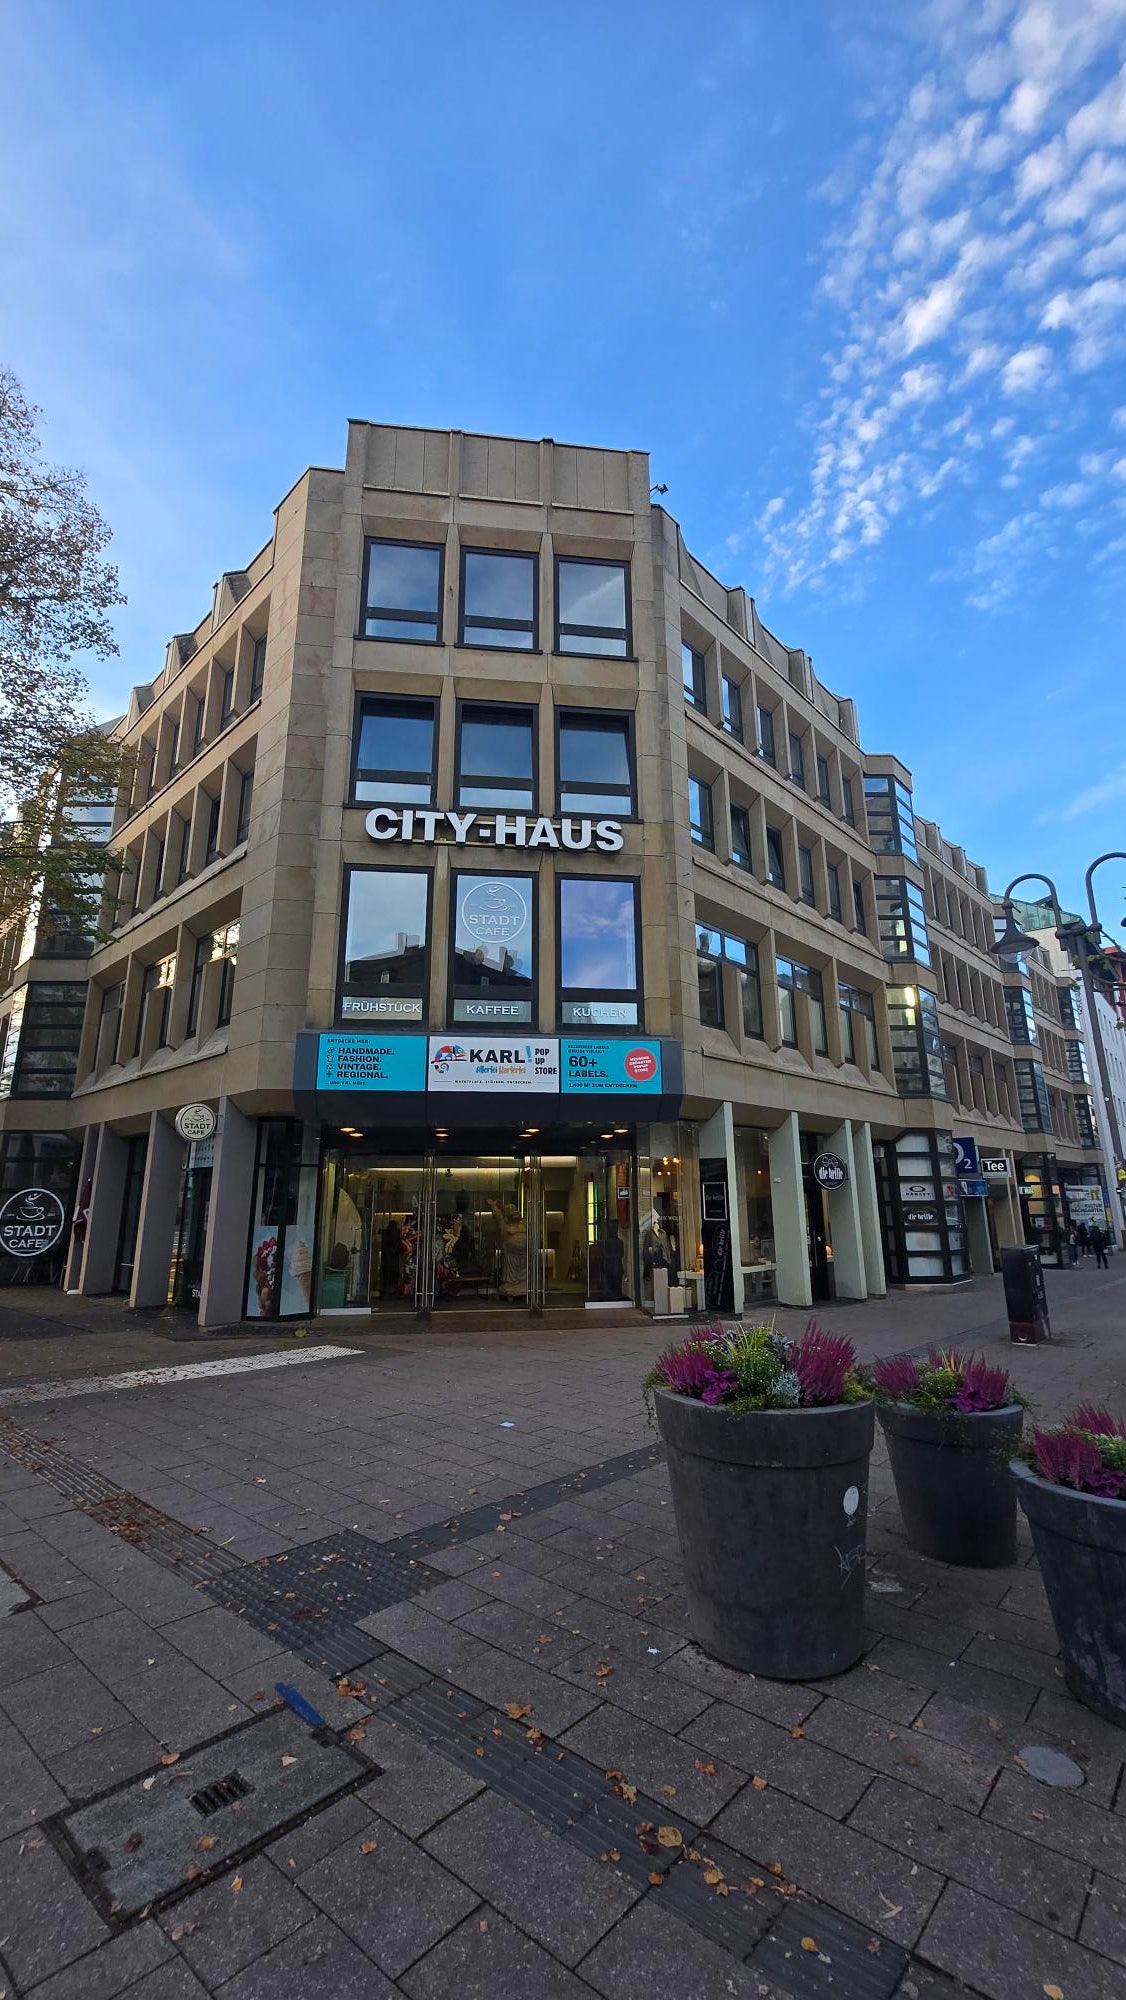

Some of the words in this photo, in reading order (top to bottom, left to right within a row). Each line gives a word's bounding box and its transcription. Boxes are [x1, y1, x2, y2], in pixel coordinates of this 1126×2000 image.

[365, 807, 624, 852] CITY-HAUS
[469, 914, 520, 926] STADT
[476, 927, 509, 936] CAFE
[343, 1000, 421, 1013] FRÜHSTÜCK
[466, 1005, 519, 1016] KAFFEE
[573, 1007, 628, 1018] KUCHEN
[470, 1046, 532, 1063] KARL!
[535, 1048, 550, 1056] POP
[535, 1057, 545, 1065] UP
[568, 1055, 598, 1067] 60+
[535, 1067, 558, 1075] STORE
[568, 1070, 609, 1078] LABELS.
[184, 1122, 211, 1130] STADT
[985, 1161, 1004, 1171] Tee
[819, 1167, 828, 1180] die
[4, 1225, 56, 1237] STADT
[9, 1239, 44, 1248] CAFE
